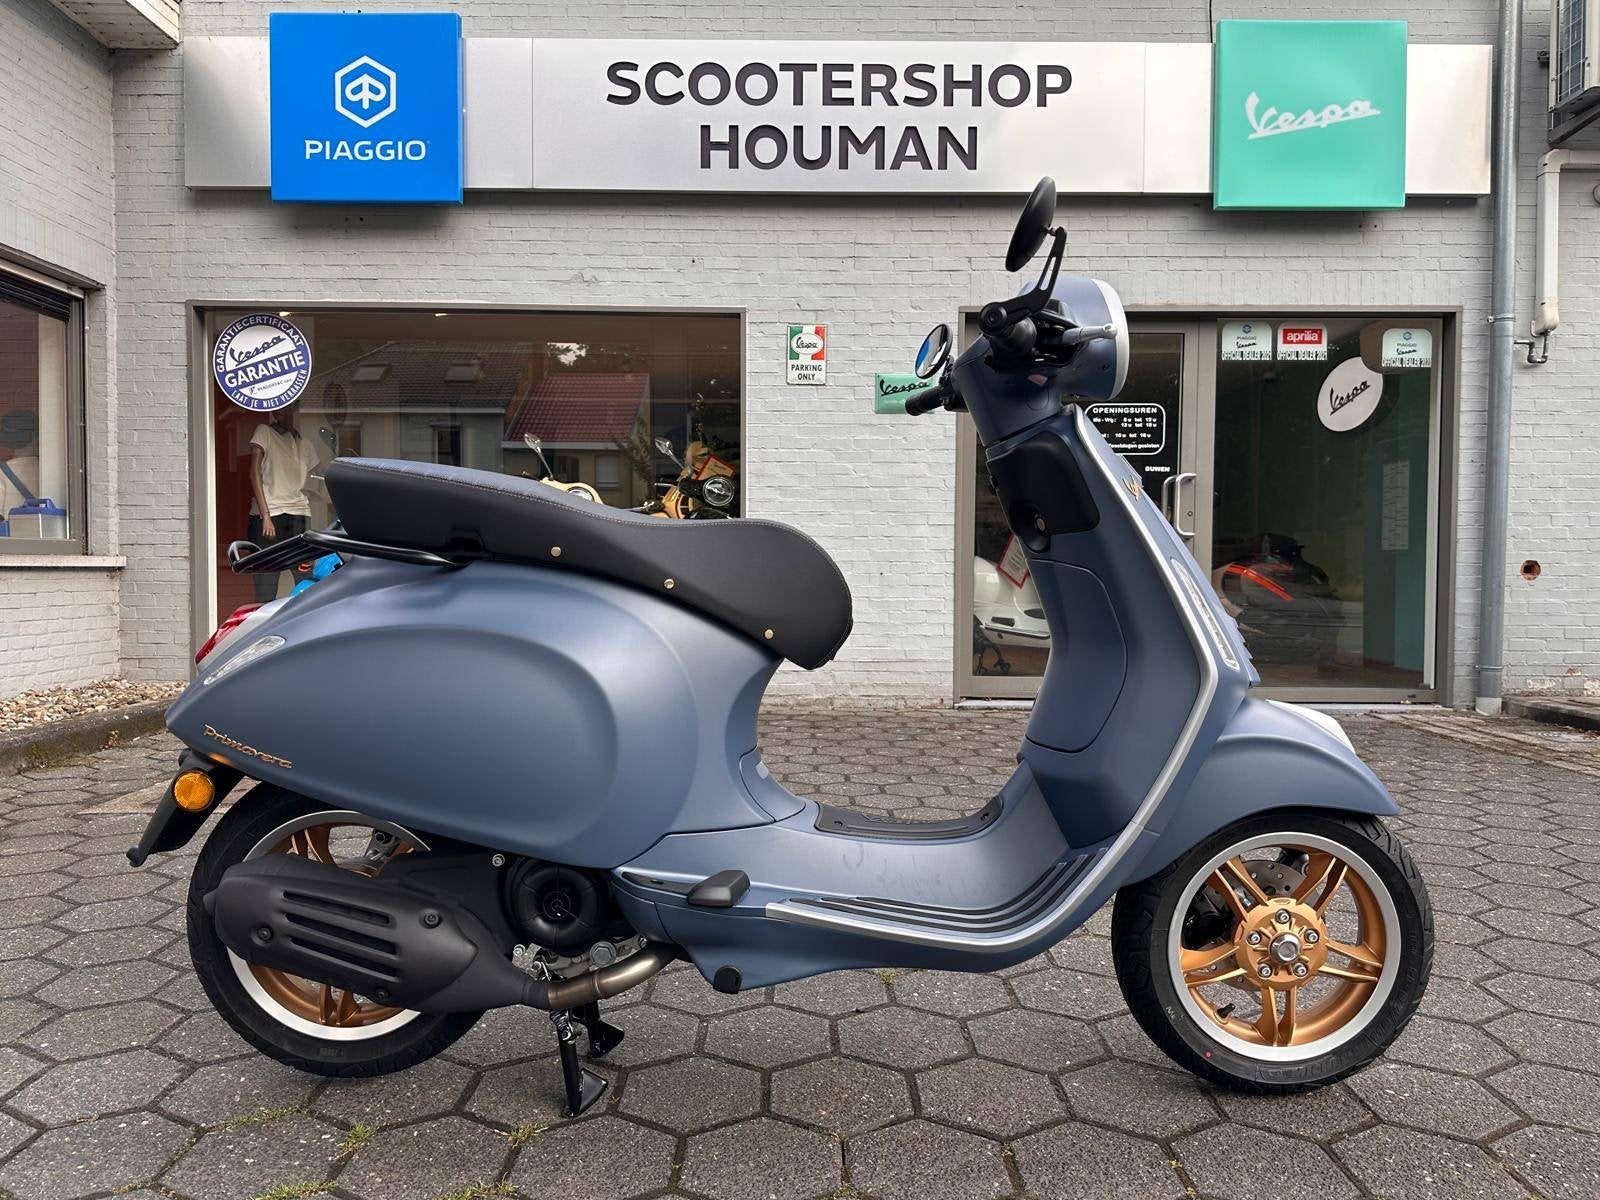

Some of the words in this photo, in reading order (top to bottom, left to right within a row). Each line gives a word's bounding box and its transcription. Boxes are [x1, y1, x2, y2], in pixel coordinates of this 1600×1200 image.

[605, 61, 1073, 108] SCOOTERSHOP
[1245, 90, 1381, 140] Vespa
[304, 139, 426, 161] PIAGGIO
[700, 124, 979, 171] HOUMAN
[216, 316, 304, 373] GARANTIECERTIFICAAT
[229, 335, 287, 368] Vespa
[796, 336, 819, 349] Vespa
[1286, 330, 1318, 343] aprilia
[224, 350, 306, 388] GARANTIE
[231, 390, 247, 404] LAAT
[250, 399, 258, 408] JE
[263, 399, 279, 408] NIET
[880, 379, 931, 397] Vespa
[1329, 380, 1371, 416] Vespa
[203, 723, 293, 769] Primavera
